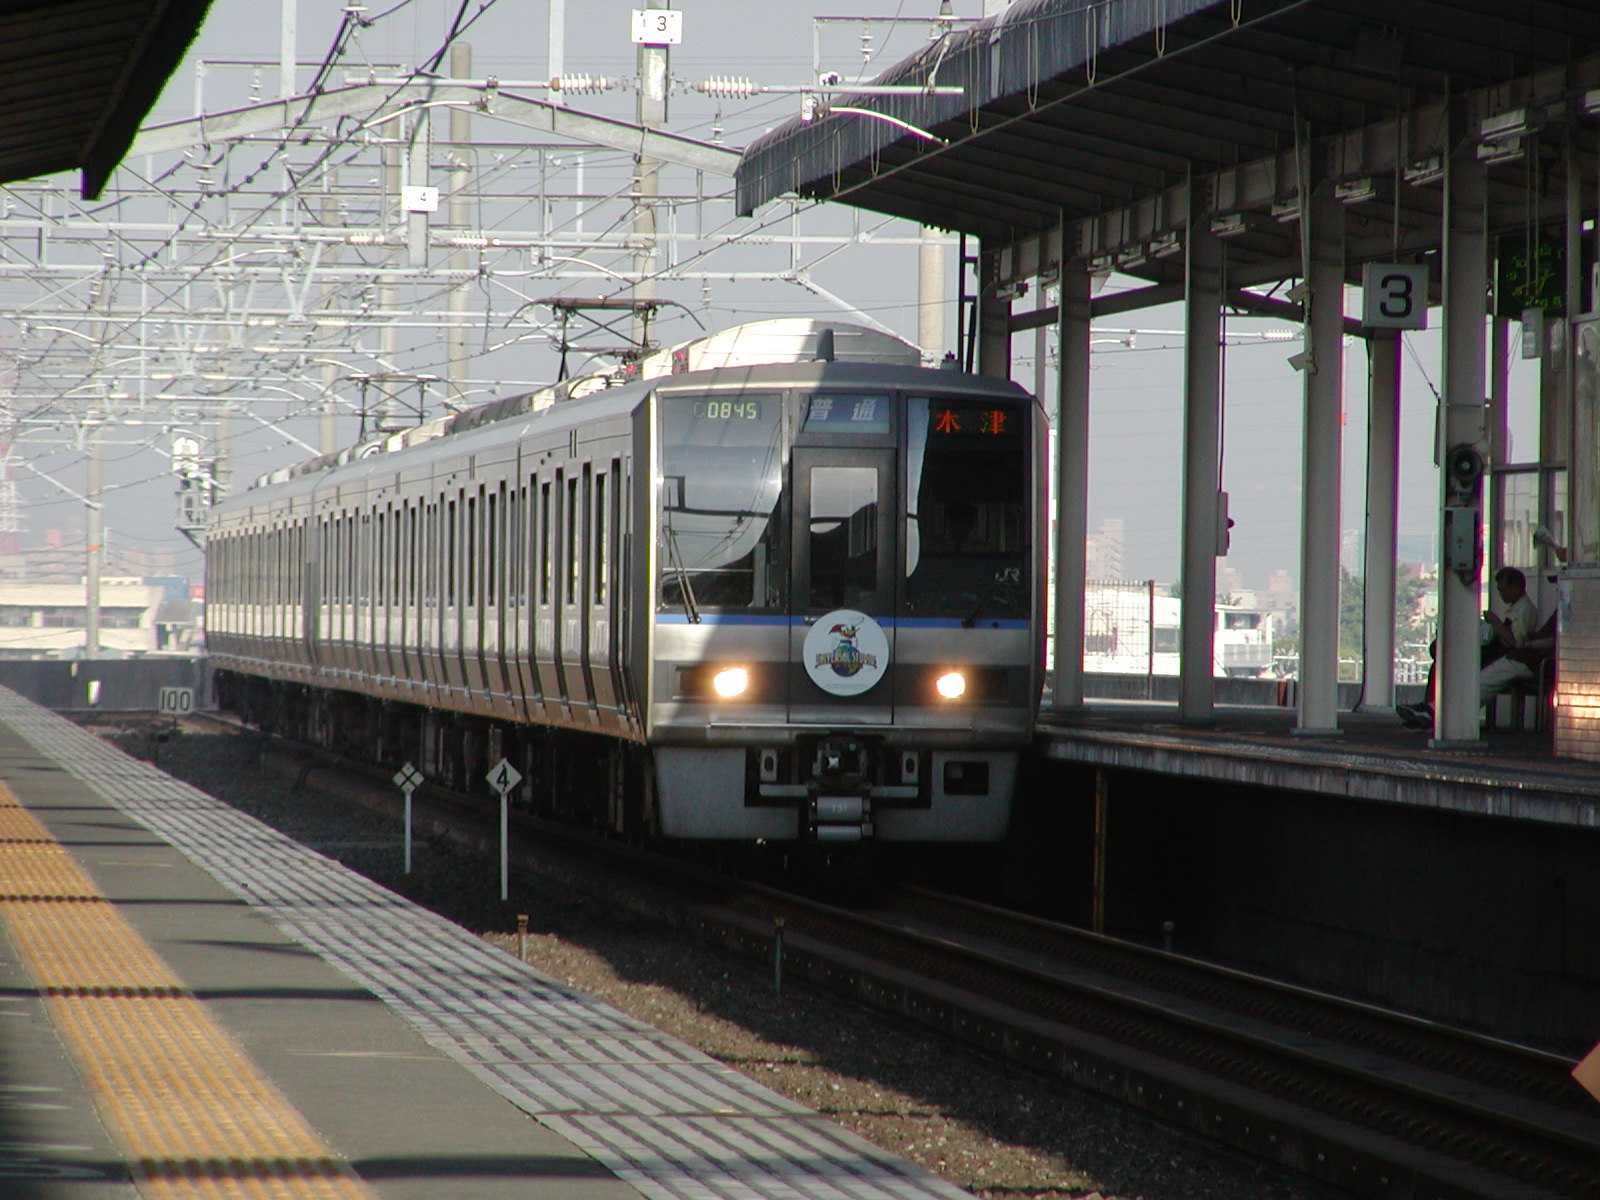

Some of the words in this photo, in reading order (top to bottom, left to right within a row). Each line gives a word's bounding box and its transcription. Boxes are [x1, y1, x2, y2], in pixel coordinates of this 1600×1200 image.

[1380, 274, 1413, 318] 3
[809, 399, 876, 421] 普通
[162, 690, 190, 711] 100
[496, 764, 509, 792] 4
